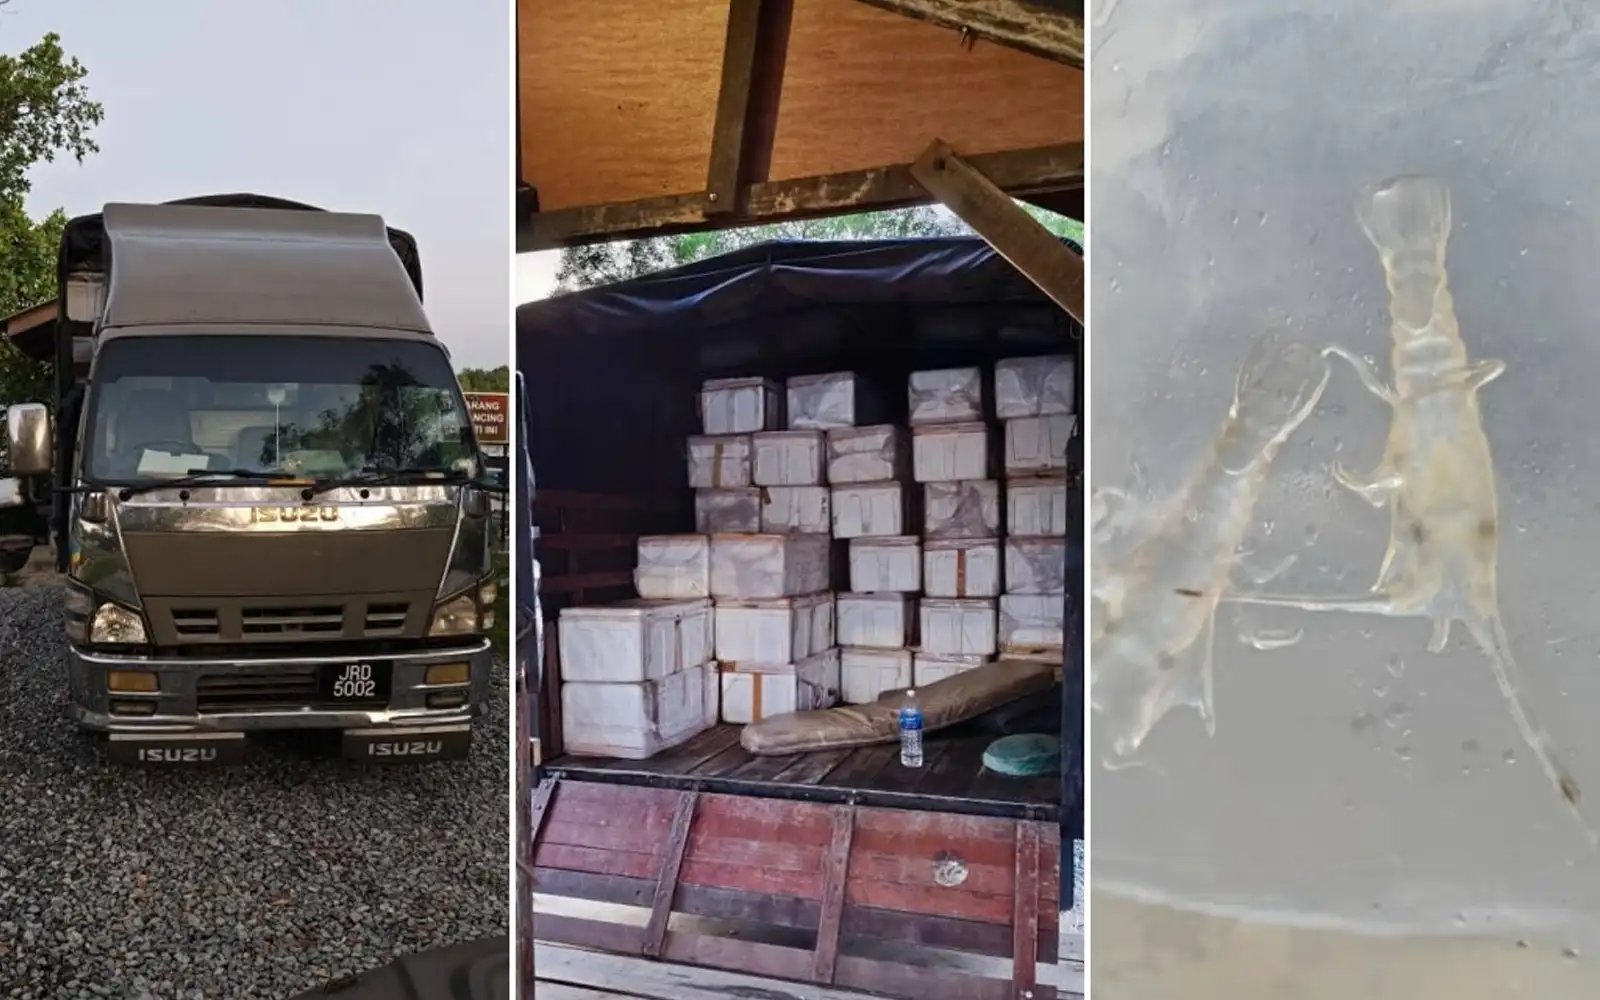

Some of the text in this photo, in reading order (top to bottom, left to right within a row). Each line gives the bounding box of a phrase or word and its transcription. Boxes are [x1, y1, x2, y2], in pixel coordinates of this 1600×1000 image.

[250, 506, 339, 523] ISUZU
[338, 664, 371, 681] JRD
[333, 680, 376, 697] 5002
[138, 747, 217, 762] ISUZU
[368, 741, 442, 756] ISUZU
